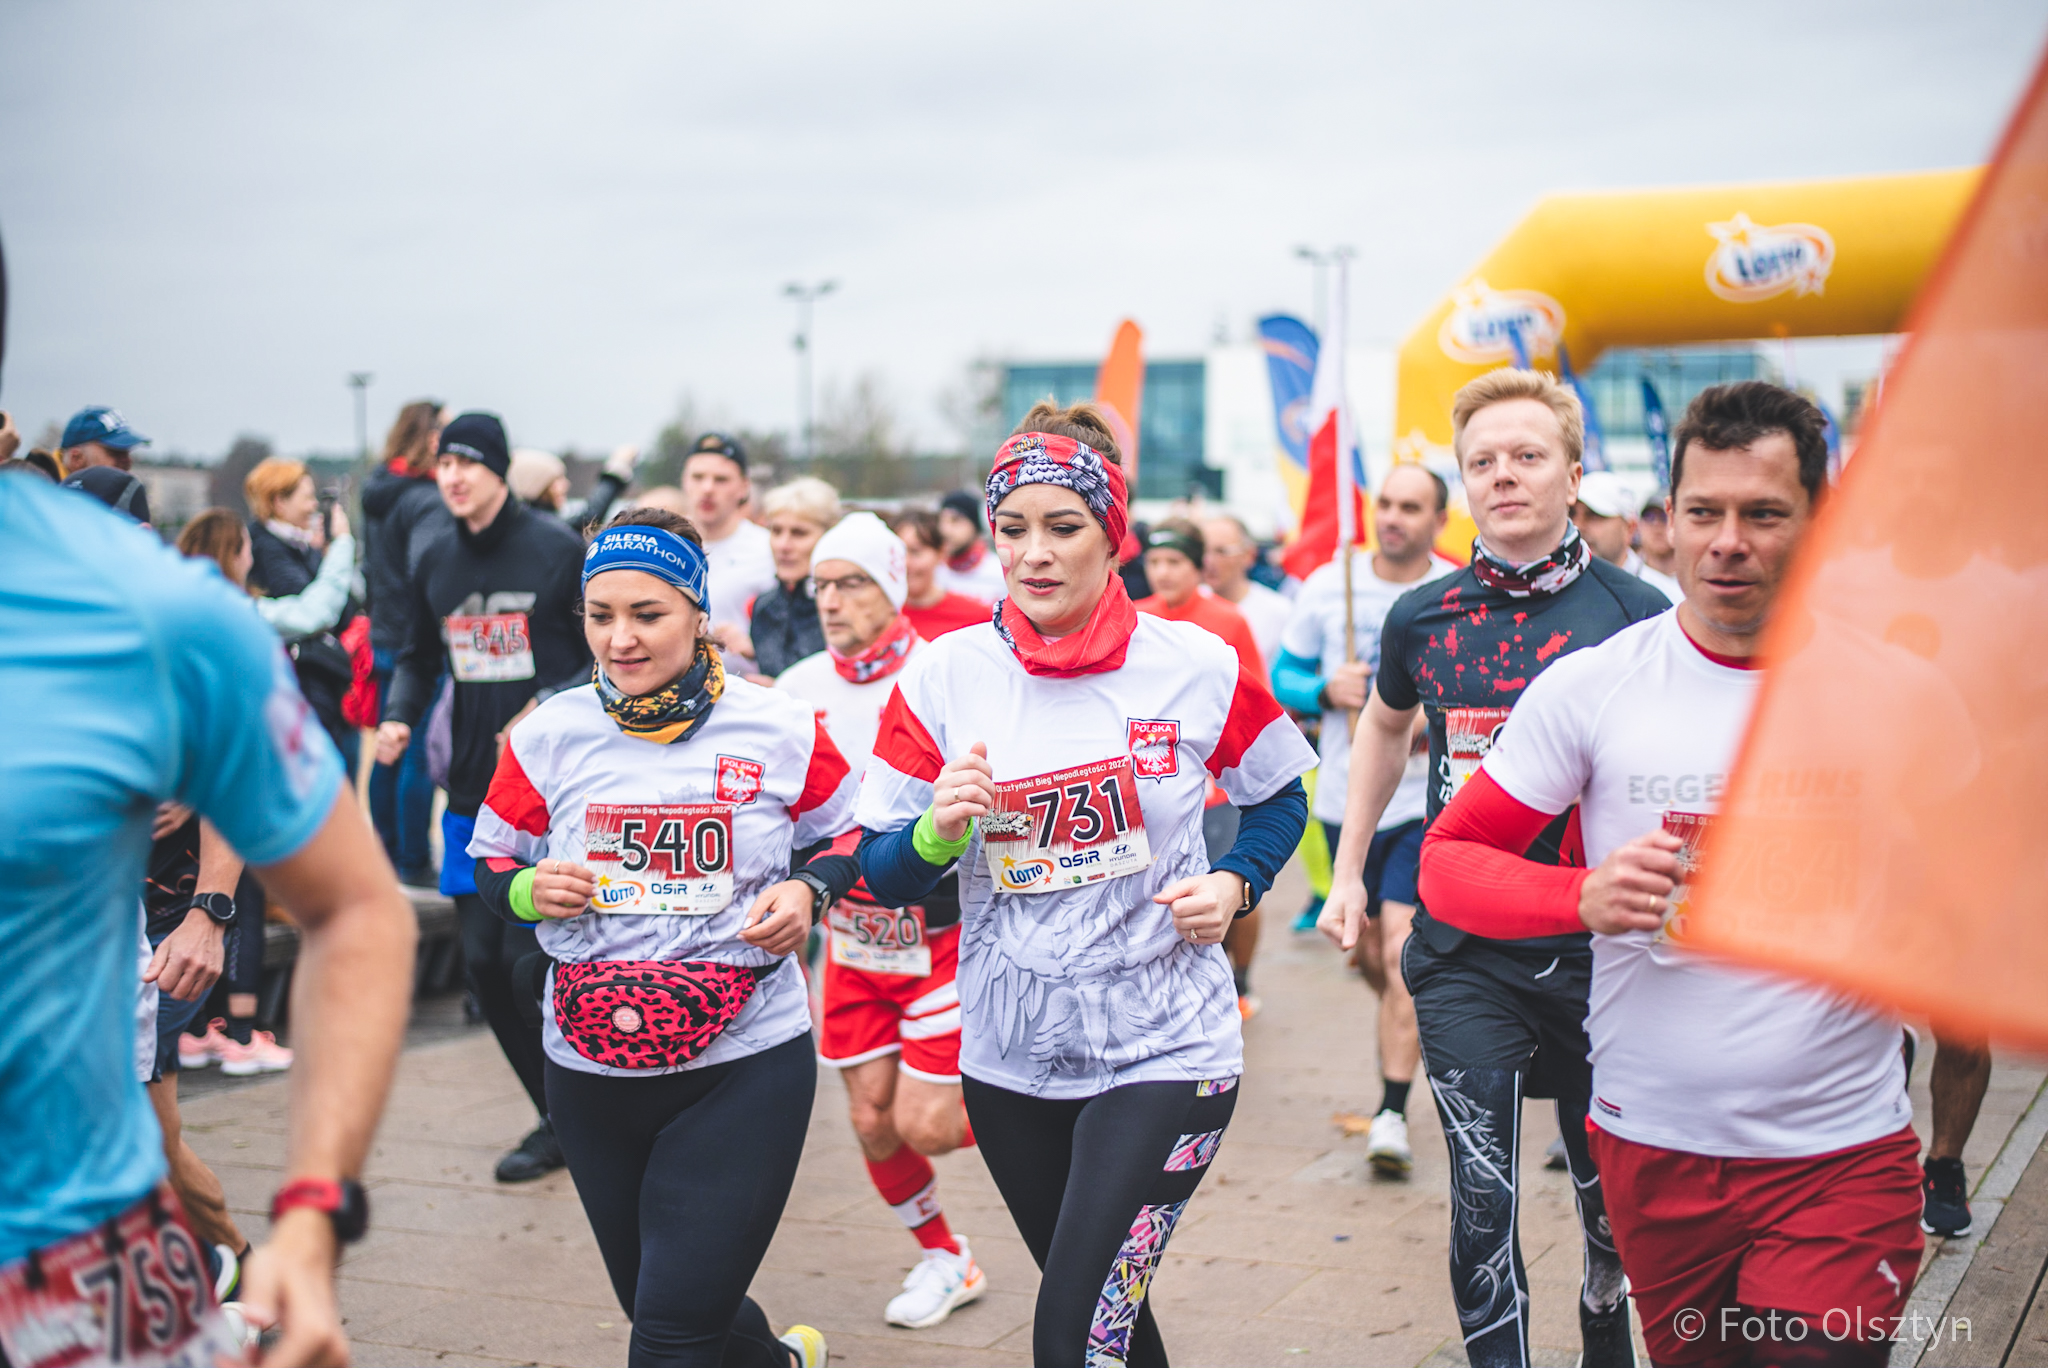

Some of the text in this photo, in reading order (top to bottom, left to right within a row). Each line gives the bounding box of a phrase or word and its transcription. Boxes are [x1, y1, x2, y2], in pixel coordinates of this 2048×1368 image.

[604, 533, 658, 546] SILESIA
[600, 541, 687, 571] MARATHON
[470, 619, 529, 655] 645
[1134, 722, 1173, 734] POLSKA
[721, 758, 759, 773] POLSKA
[995, 779, 1035, 793] Olsztyński
[1035, 776, 1052, 787] Bieg
[1053, 763, 1107, 783] Niepodległości
[642, 806, 658, 816] Bieg
[1026, 775, 1129, 850] 731
[621, 818, 728, 874] 540
[1008, 864, 1044, 886] LOTTO
[602, 886, 636, 904] LOTTO
[852, 911, 922, 949] 520
[71, 1221, 210, 1366] 759
